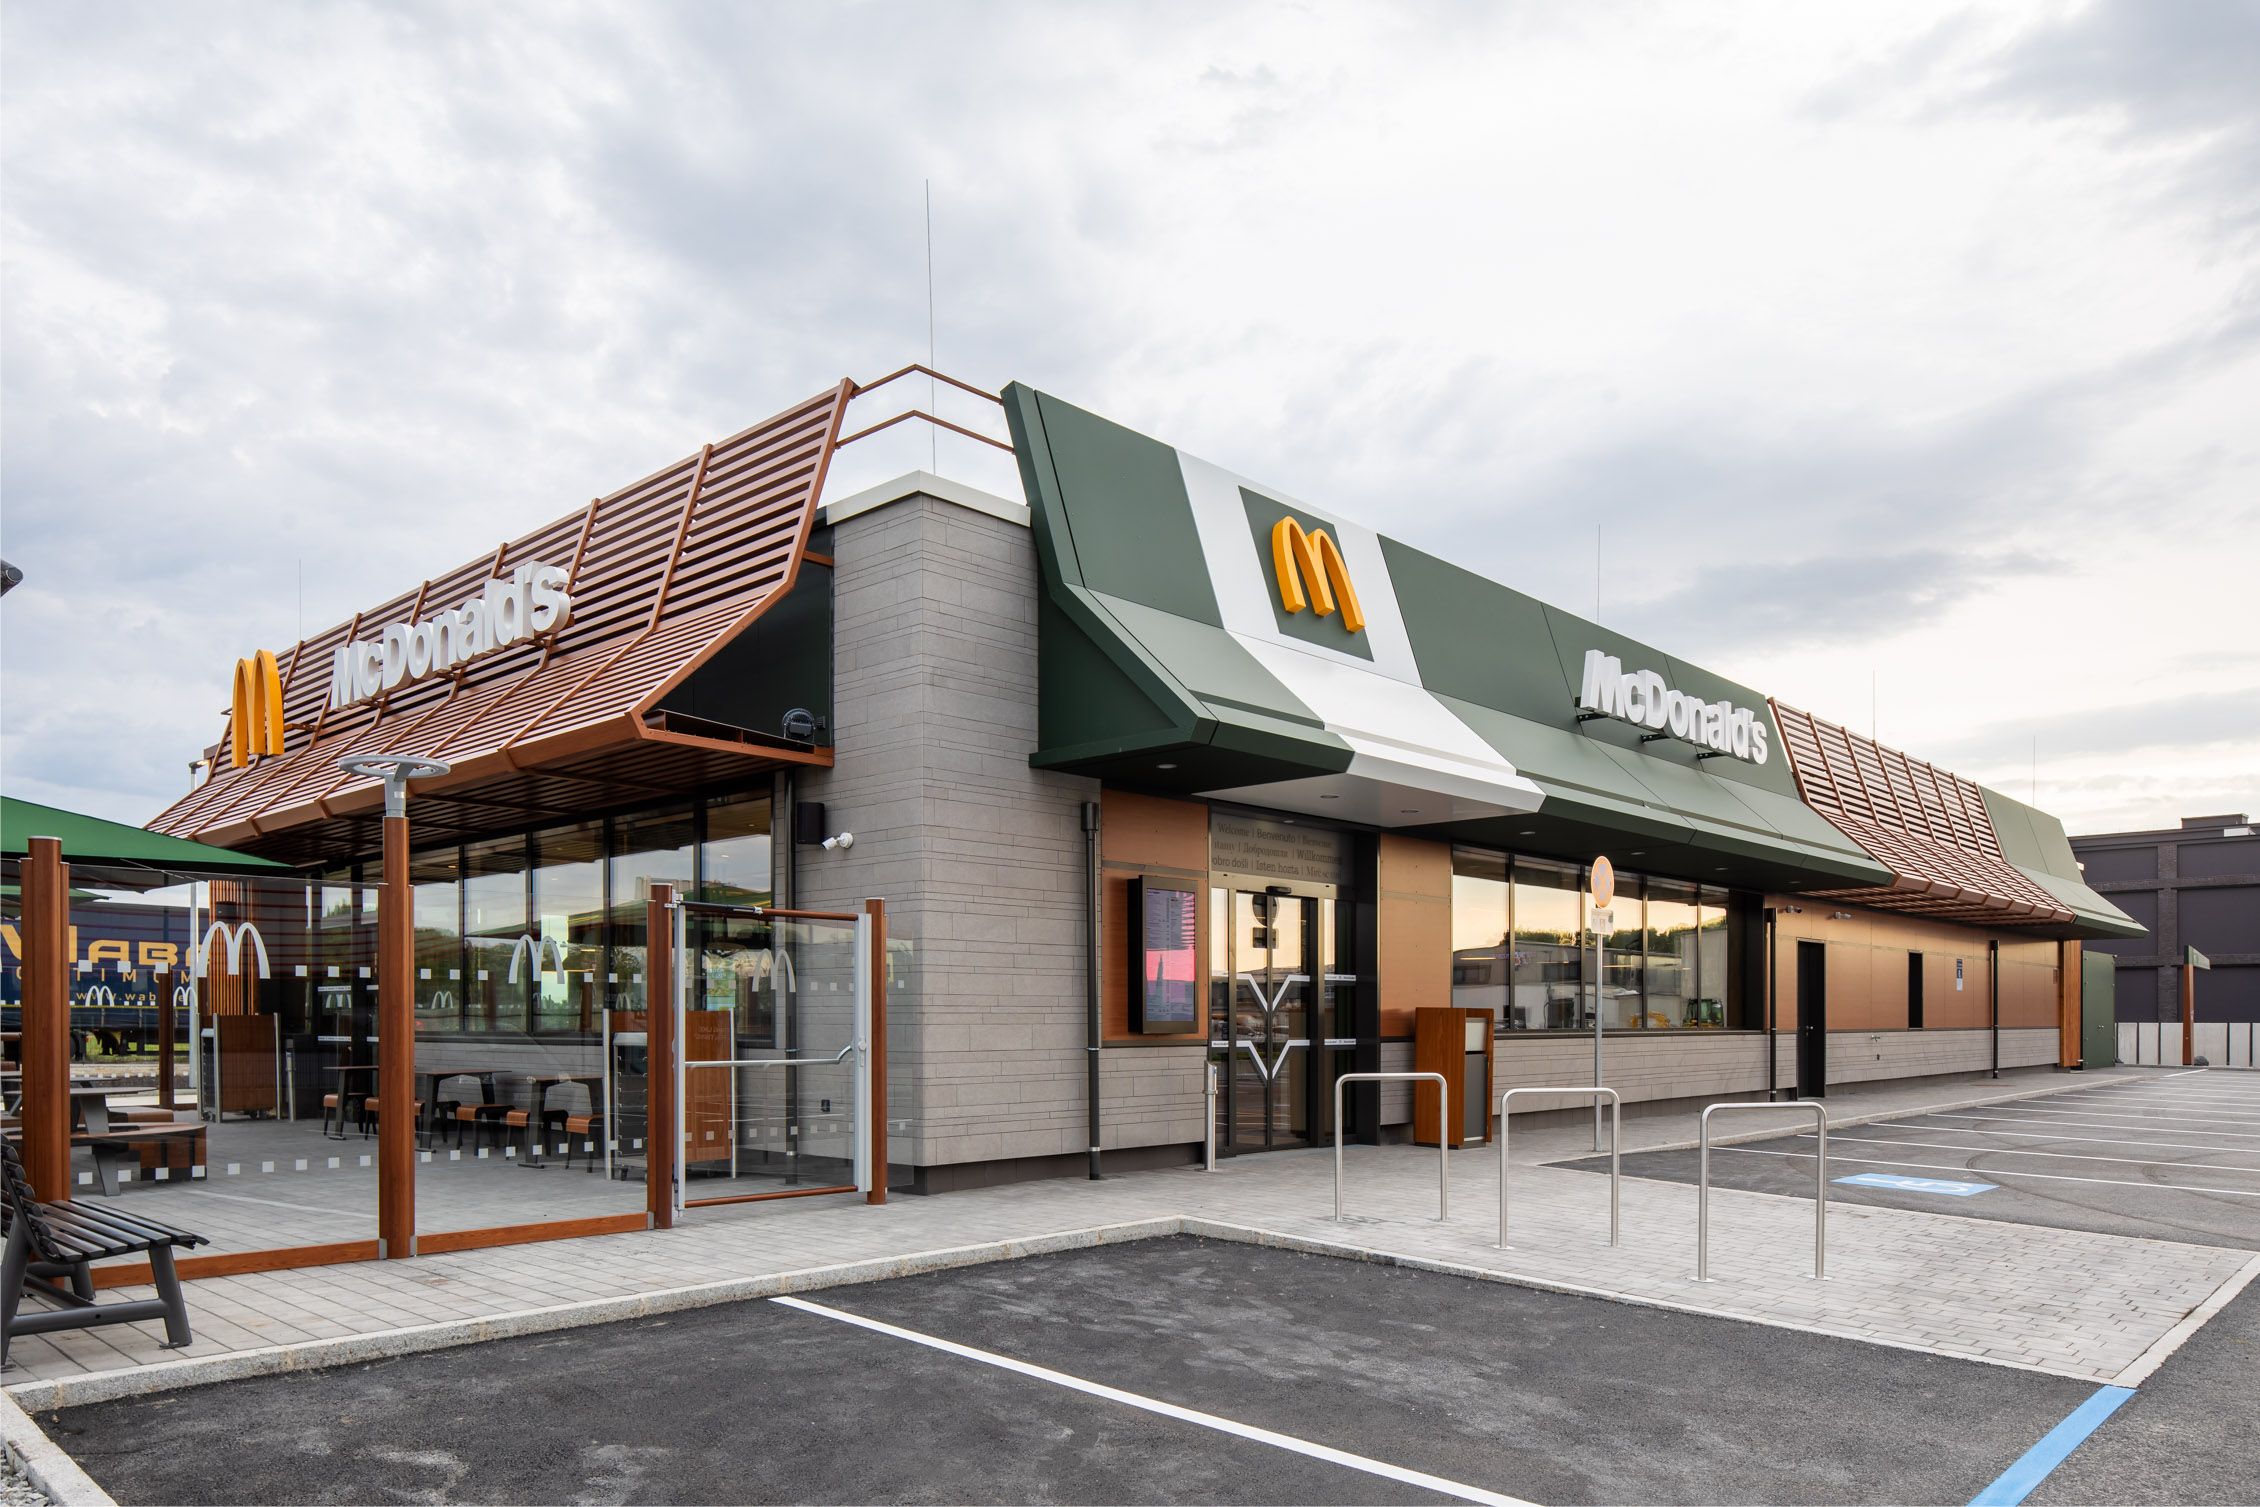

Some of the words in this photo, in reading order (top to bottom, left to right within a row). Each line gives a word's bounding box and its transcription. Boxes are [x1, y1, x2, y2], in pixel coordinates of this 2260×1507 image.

[331, 561, 571, 711] McDonald's
[1580, 649, 1768, 765] McDonald's
[1217, 823, 1249, 838] Welcome
[1256, 828, 1296, 844] Benvenuto
